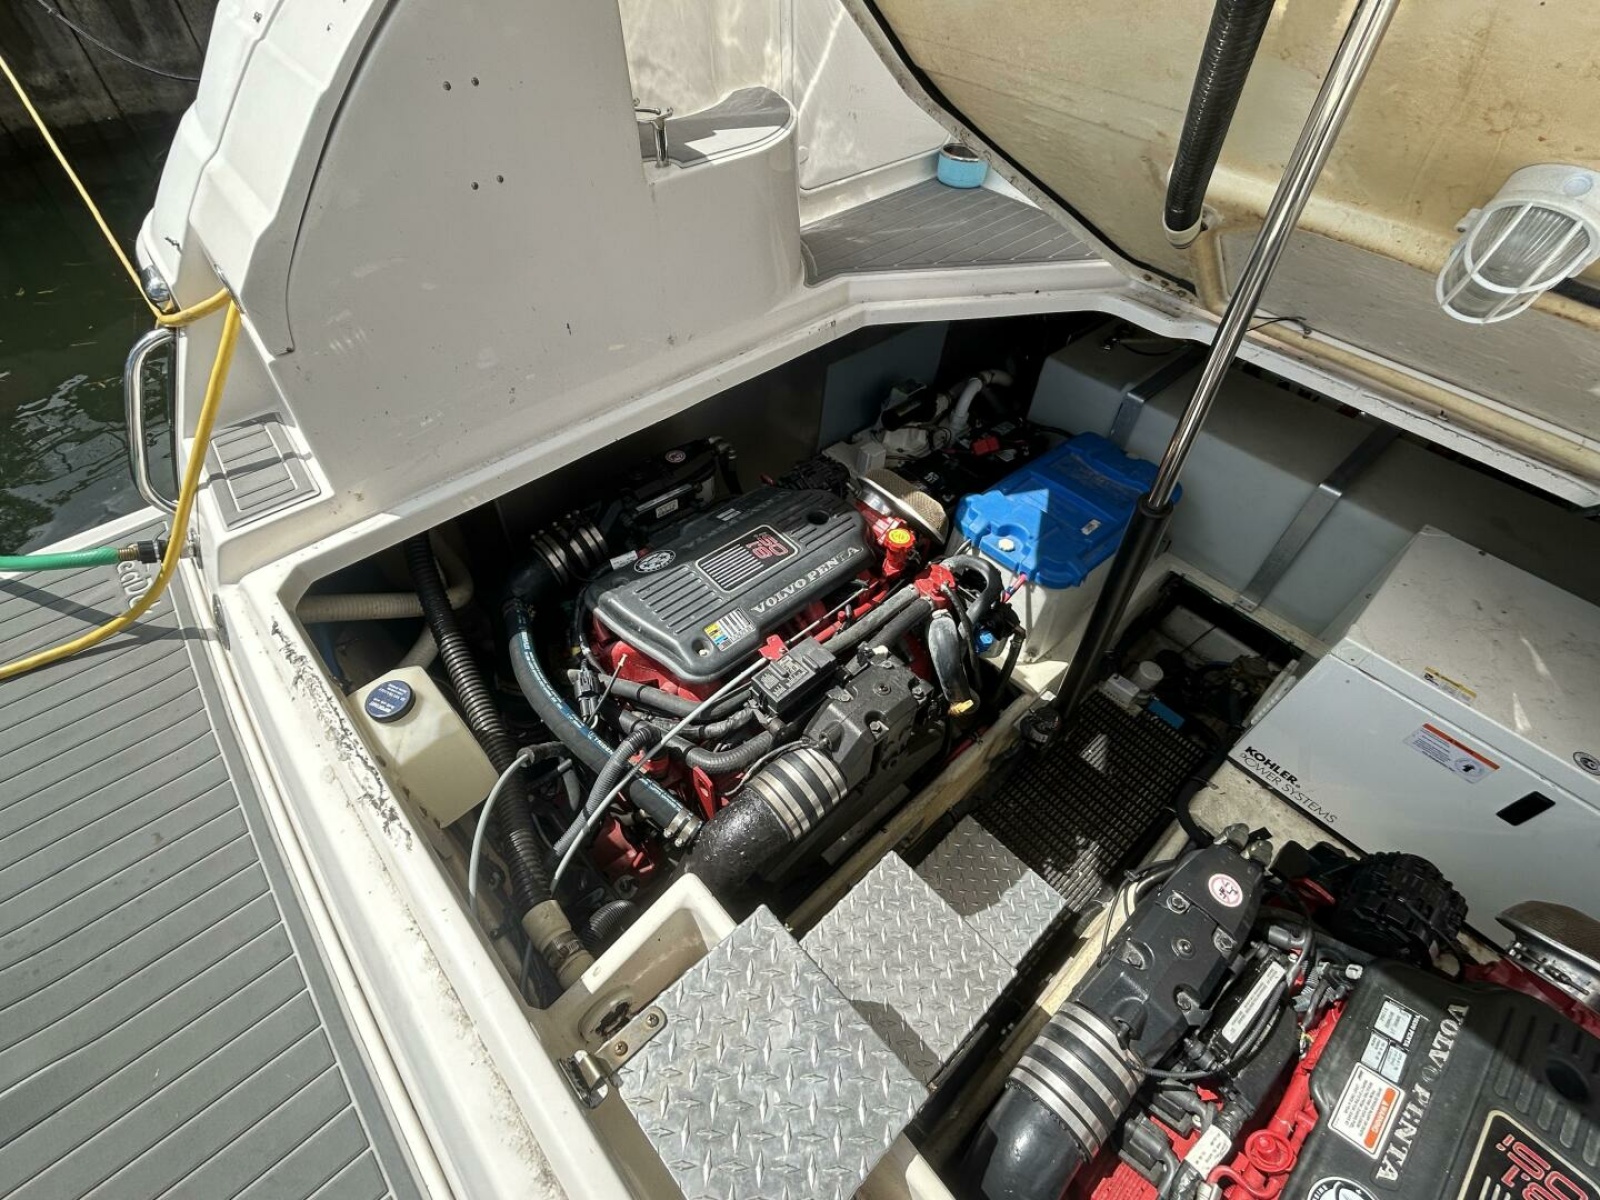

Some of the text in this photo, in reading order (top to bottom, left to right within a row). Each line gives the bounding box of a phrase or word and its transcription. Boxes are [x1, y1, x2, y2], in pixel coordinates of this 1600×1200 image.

[750, 547, 860, 613] VOLVO PENTA
[1240, 753, 1338, 823] POWER SYSTEMS
[1245, 746, 1299, 786] KOHLER
[1421, 1004, 1470, 1083] VOLVO
[1375, 1082, 1432, 1181] PENTA
